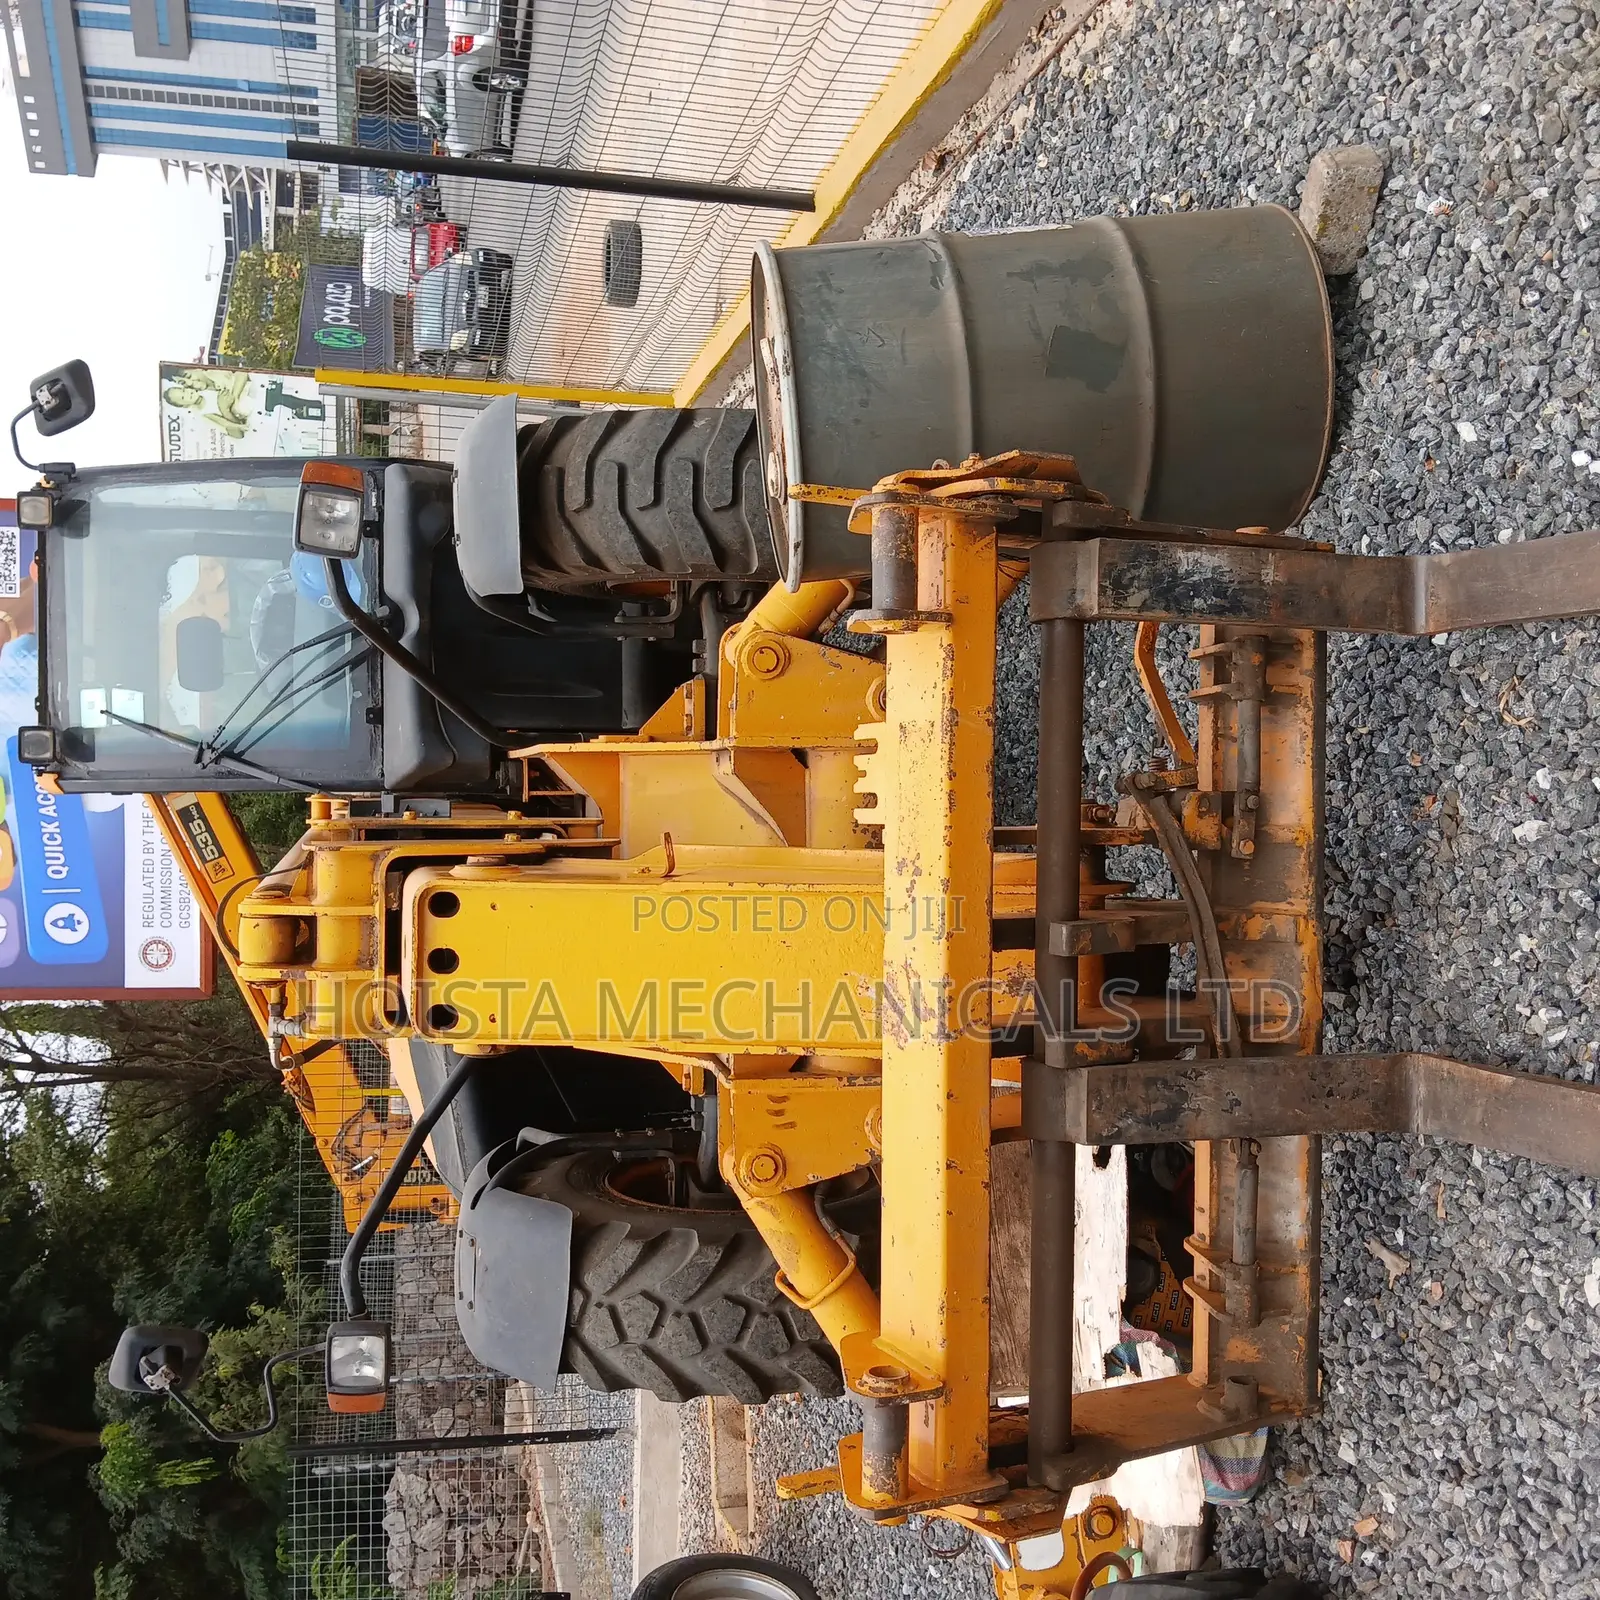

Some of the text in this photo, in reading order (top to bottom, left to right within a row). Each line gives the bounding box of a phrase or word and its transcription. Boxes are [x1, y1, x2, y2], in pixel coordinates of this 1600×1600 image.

[142, 812, 154, 836] THE
[40, 821, 69, 880] QUICK
[142, 840, 154, 854] BY
[189, 819, 218, 860] 535
[213, 862, 226, 878] JCB
[142, 858, 154, 928] REGULATED
[160, 848, 172, 928] COMMISSION
[178, 869, 190, 929] GCSB240
[1152, 1303, 1160, 1322] JCB
[1170, 1291, 1179, 1310] JCB
[1182, 1308, 1191, 1327] JCB
